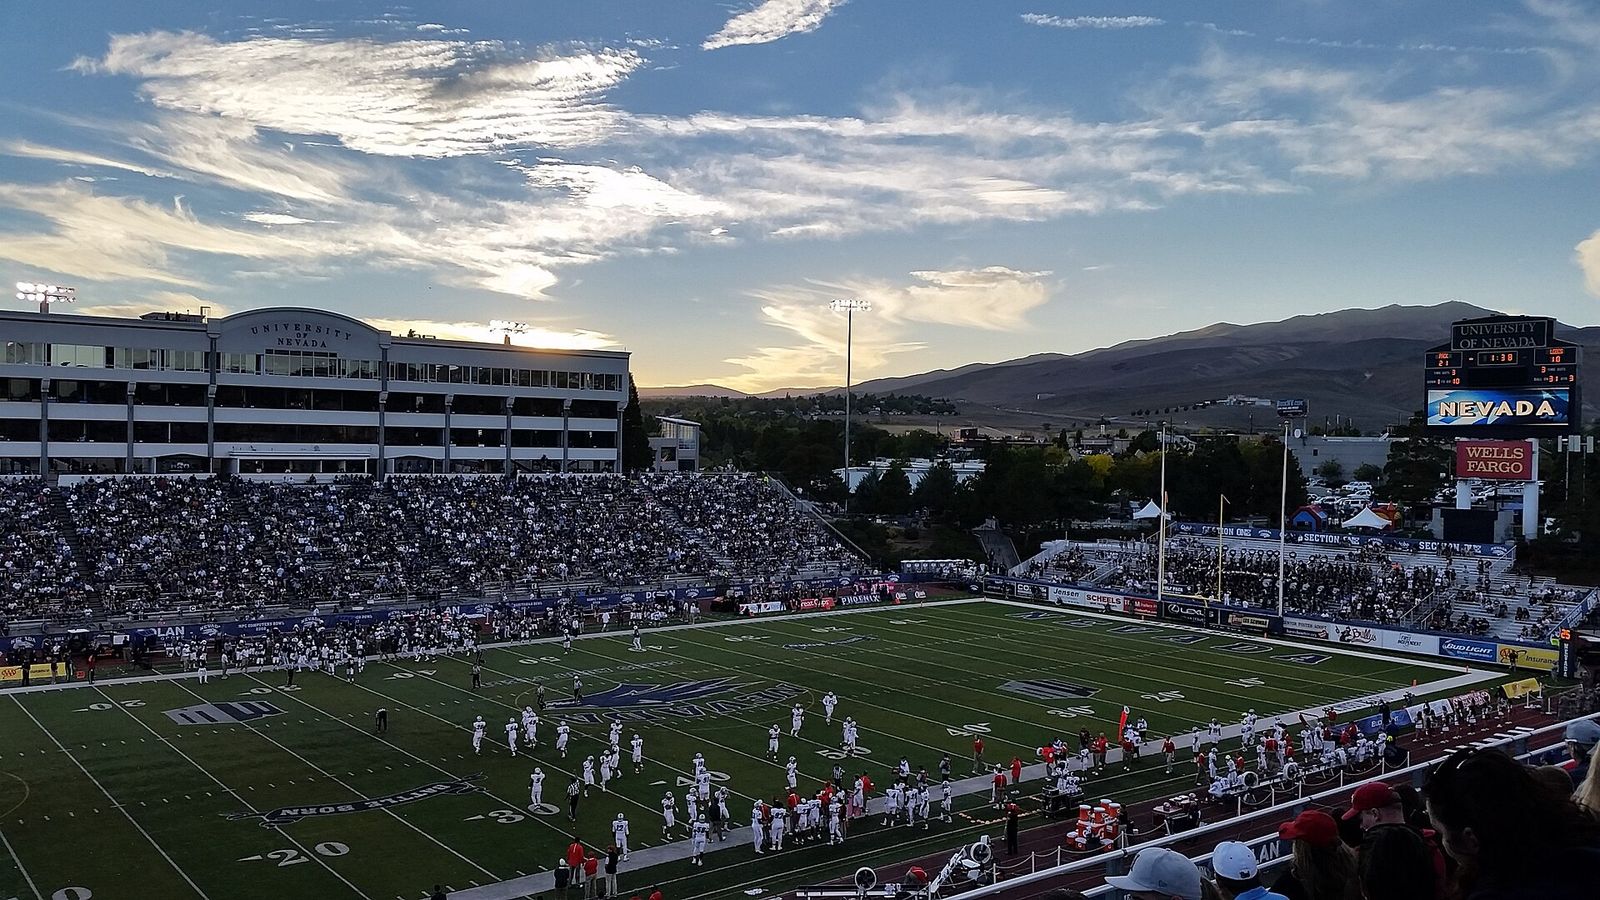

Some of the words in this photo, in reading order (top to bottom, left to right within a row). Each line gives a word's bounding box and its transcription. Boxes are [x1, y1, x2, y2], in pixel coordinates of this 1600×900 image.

[250, 323, 352, 341] UNIVERSITY
[1461, 322, 1537, 336] UNIVERSITY
[277, 337, 327, 348] NEVADA
[1459, 338, 1478, 350] OF
[1481, 336, 1537, 348] NEVADA
[1489, 353, 1513, 362] 1:38
[1551, 355, 1561, 363] 10
[1452, 377, 1460, 385] 10
[1439, 400, 1555, 417] NEVADA
[1466, 446, 1524, 459] WELLS
[1466, 461, 1523, 474] FARGO
[1236, 528, 1251, 537] ONE
[1304, 533, 1340, 543] SECTION
[840, 594, 881, 605] PHOENIX
[1053, 588, 1080, 598] Jensen
[1086, 594, 1122, 605] SCHEELS
[1560, 628, 1571, 641] 25
[1446, 642, 1465, 651] BUD
[1465, 646, 1493, 655] LIGHT
[1141, 690, 1185, 703] 20
[1046, 705, 1096, 718] 30
[946, 722, 992, 737] 40
[364, 783, 451, 808] BATTLE
[279, 804, 354, 816] BORN
[488, 802, 560, 824] 30
[267, 841, 350, 867] 20
